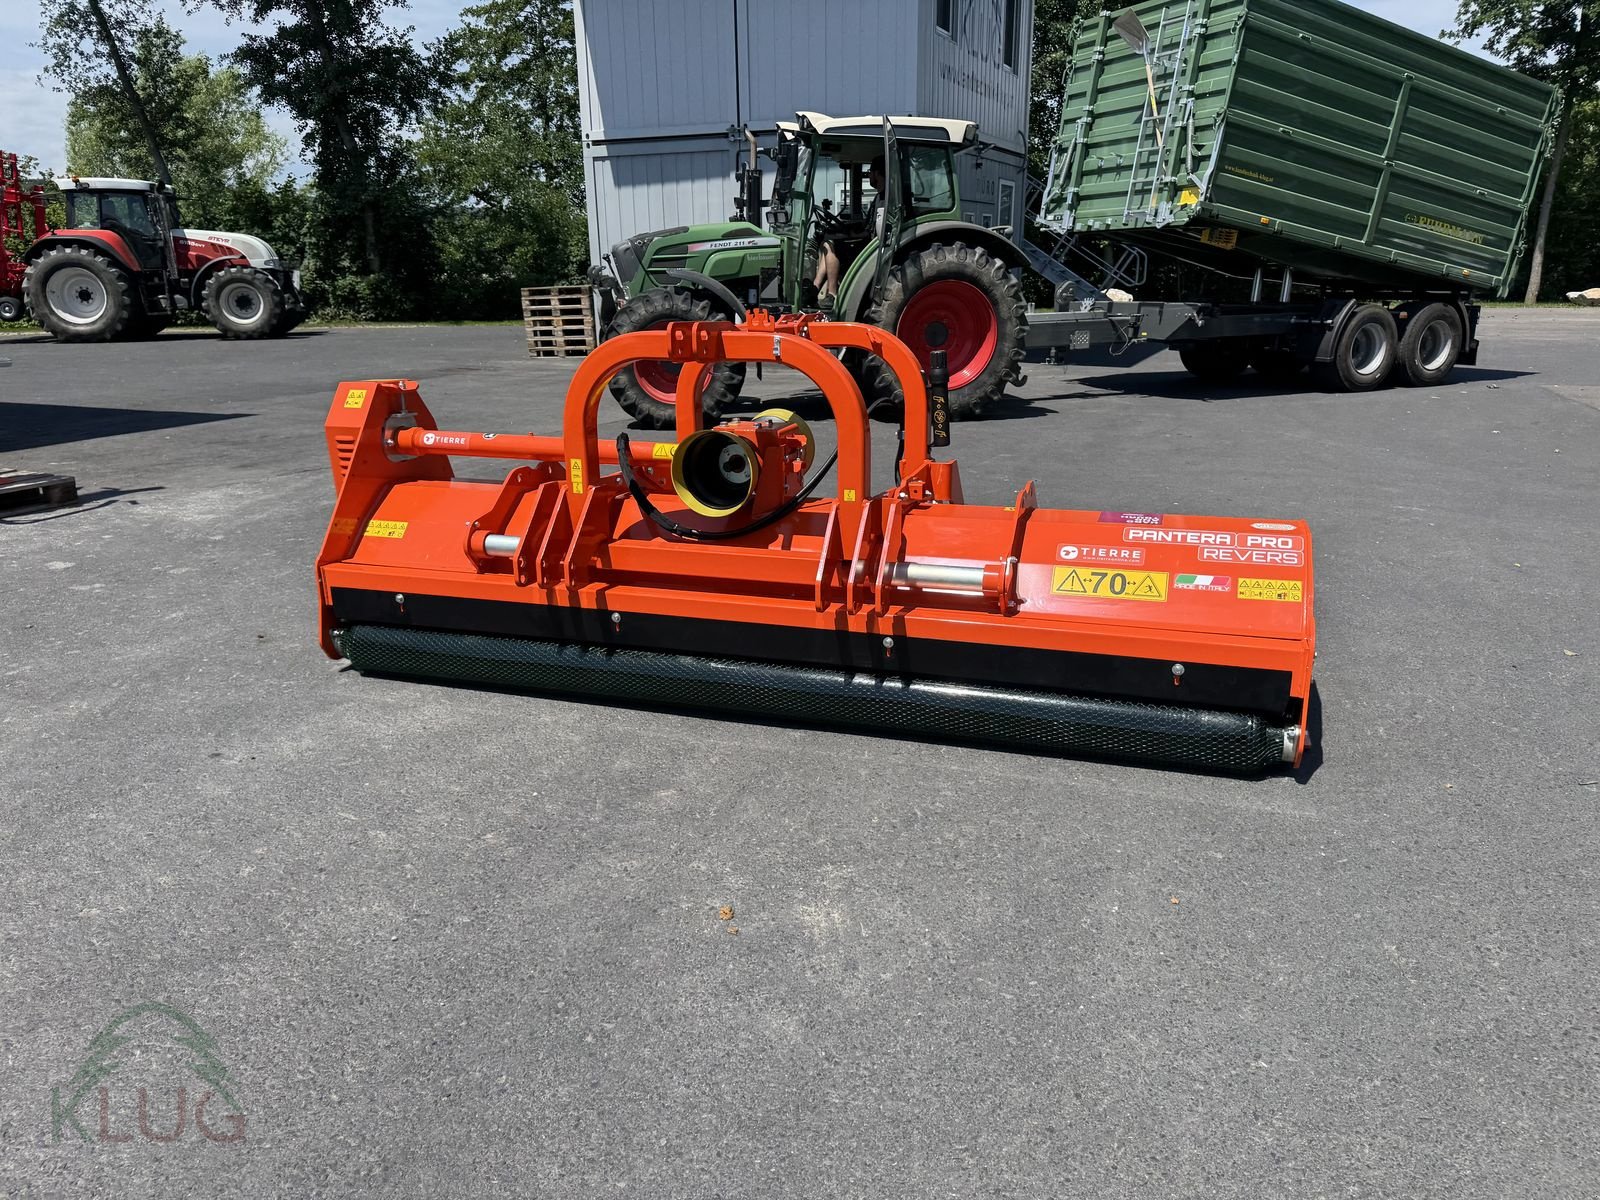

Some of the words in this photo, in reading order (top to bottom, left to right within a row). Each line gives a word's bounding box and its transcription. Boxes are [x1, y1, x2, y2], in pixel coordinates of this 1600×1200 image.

[208, 235, 230, 243] STEYR
[709, 241, 733, 249] FENDT
[435, 436, 466, 445] TIERRE
[1127, 530, 1232, 546] PANTERA
[1246, 535, 1293, 549] PRO
[1081, 547, 1142, 559] TIERRE
[1203, 549, 1298, 564] REVERS
[1090, 571, 1127, 596] 70
